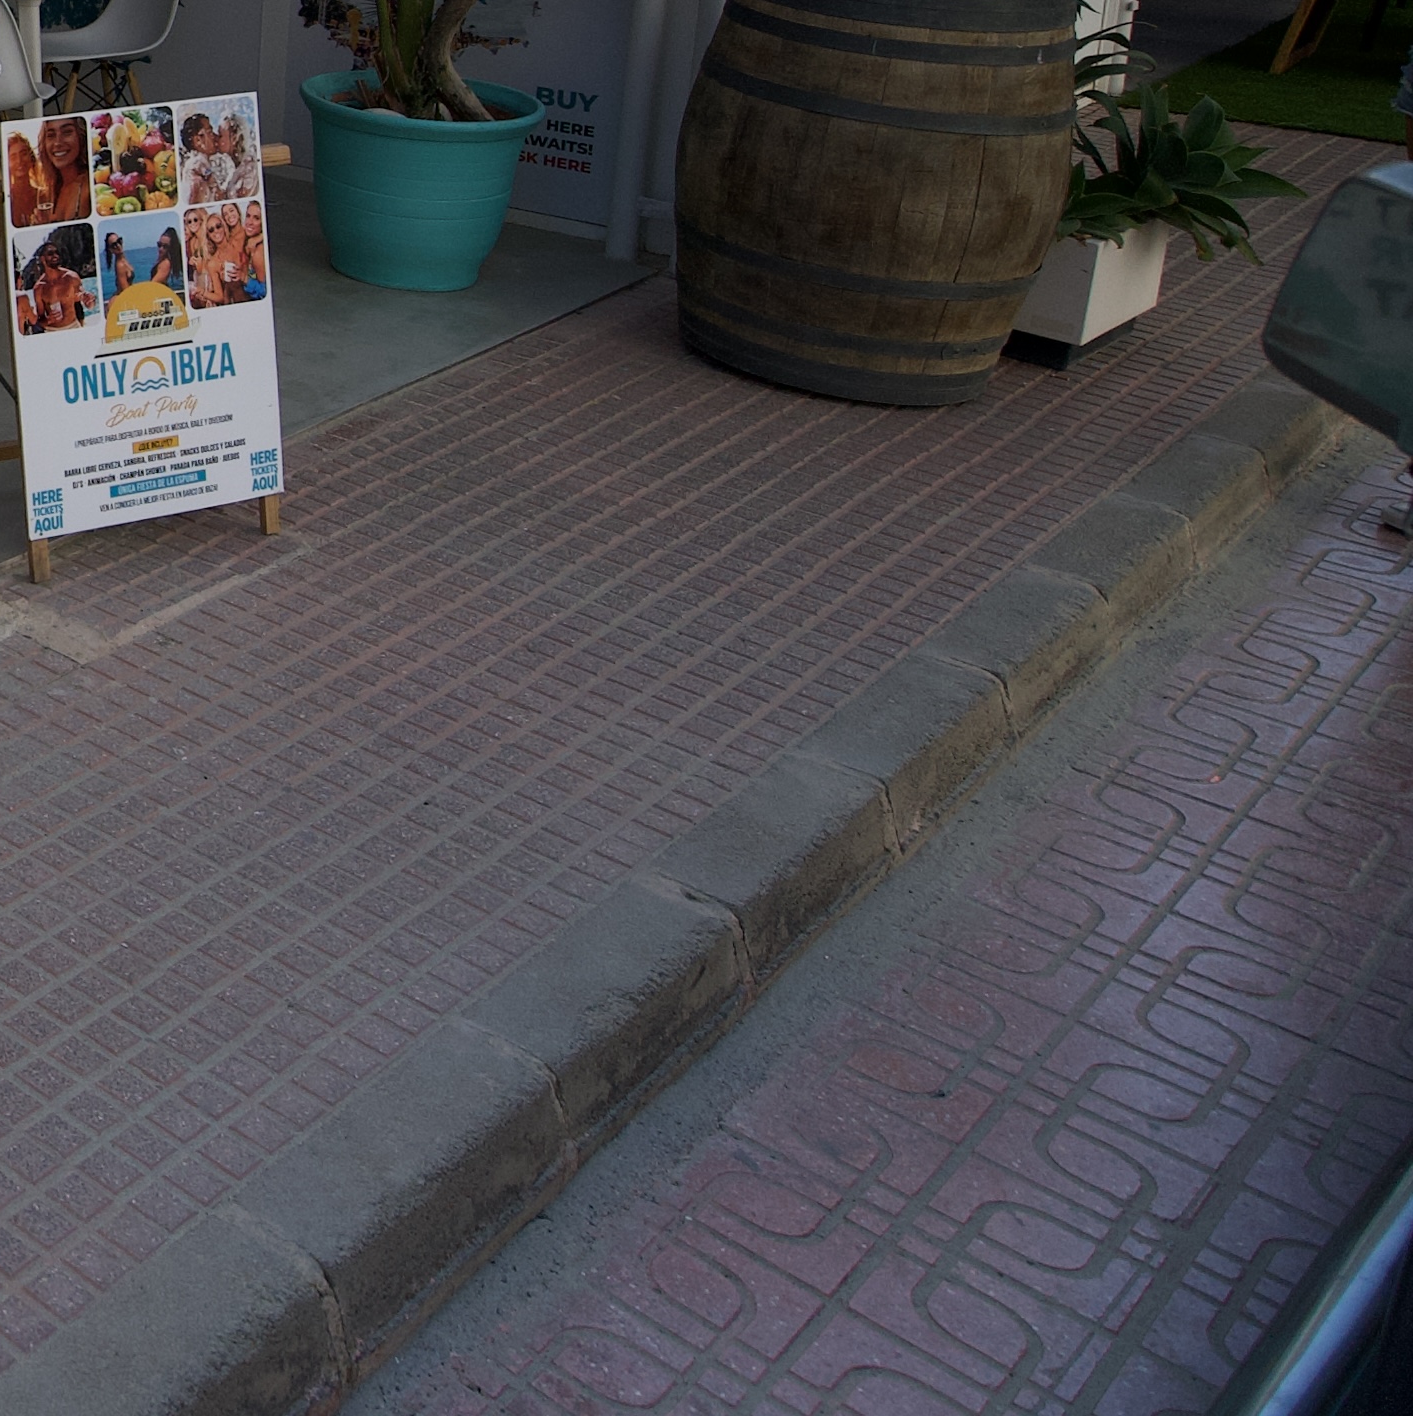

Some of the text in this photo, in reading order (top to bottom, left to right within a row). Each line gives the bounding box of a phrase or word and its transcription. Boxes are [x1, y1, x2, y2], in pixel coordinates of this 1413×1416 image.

[536, 86, 599, 112] BUY
[546, 119, 596, 138] HERE
[543, 154, 592, 175] HERE
[63, 342, 236, 404] ONLY IBIZA
[106, 393, 199, 428] Boat Party
[250, 448, 278, 466] HERE
[251, 463, 278, 477] TICKETS
[32, 488, 63, 507] HERE
[33, 504, 64, 518] TICKETS
